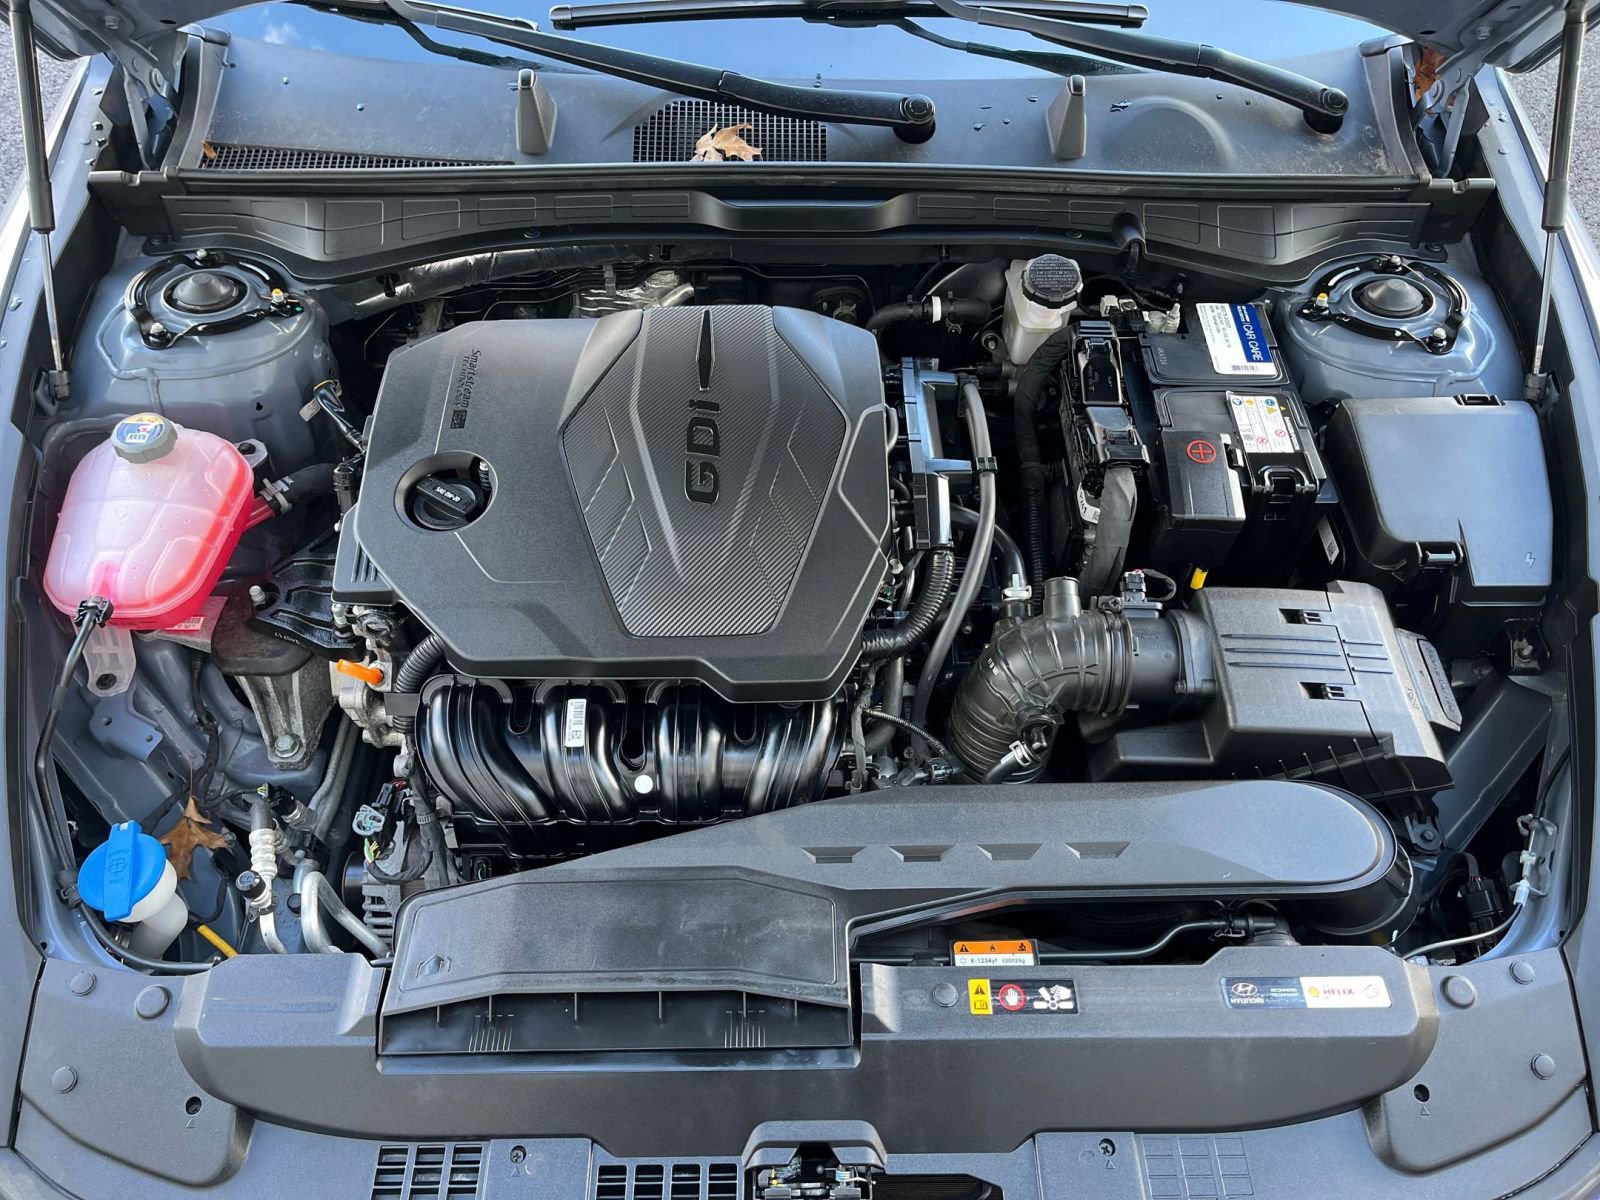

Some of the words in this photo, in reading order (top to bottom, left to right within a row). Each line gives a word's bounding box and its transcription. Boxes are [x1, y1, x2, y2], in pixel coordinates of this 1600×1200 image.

[1242, 324, 1257, 340] CAR
[1248, 341, 1264, 361] CARE
[460, 347, 482, 408] Smartstream
[434, 486, 447, 495] SAE
